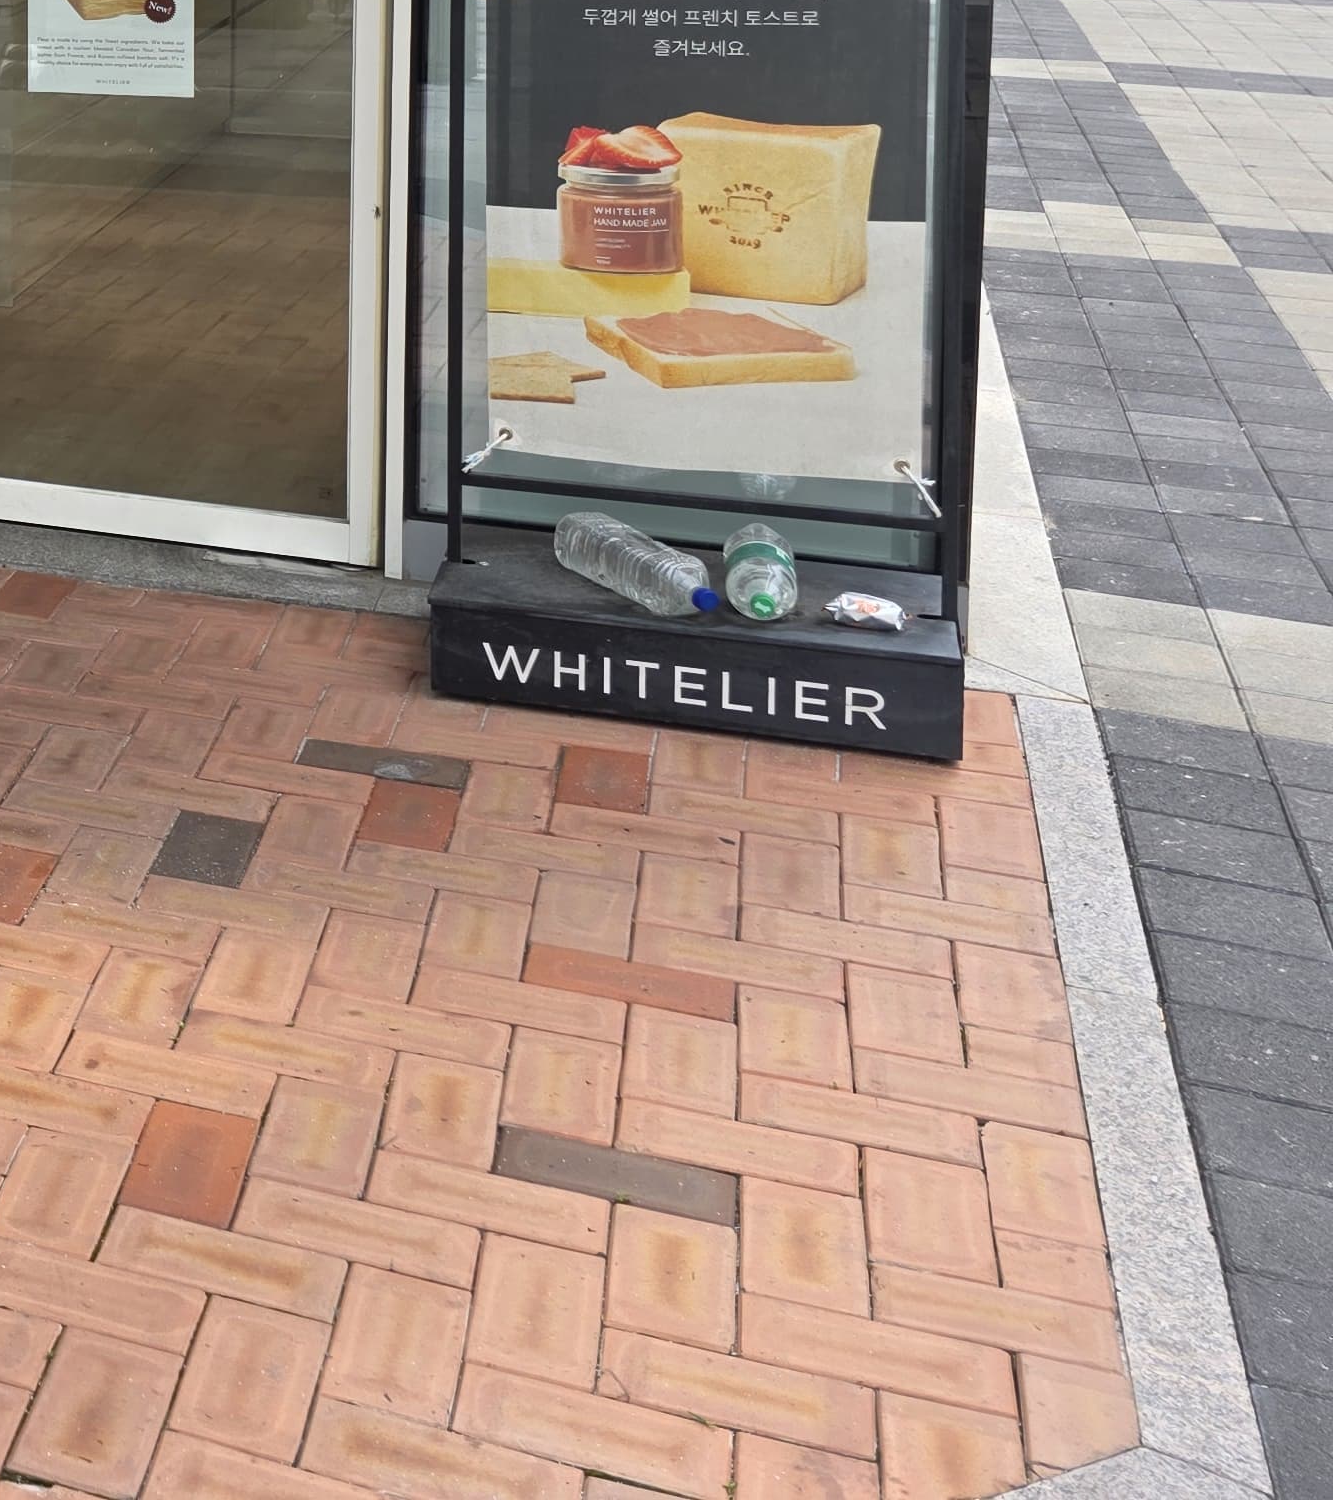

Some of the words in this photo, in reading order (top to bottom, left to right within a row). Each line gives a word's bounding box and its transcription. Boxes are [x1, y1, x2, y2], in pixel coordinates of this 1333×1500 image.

[148, 1, 171, 15] New!
[582, 8, 636, 27] 두껍게
[641, 8, 677, 27] 썰어
[684, 8, 738, 27] 프렌치
[744, 8, 819, 27] 토스트로
[652, 38, 750, 58] 즐겨보세요.
[593, 206, 657, 216] WHITELIER
[593, 217, 620, 228] HAND
[622, 218, 649, 228] MADE
[650, 218, 667, 227] JAM
[482, 641, 887, 731] WHITELIER
